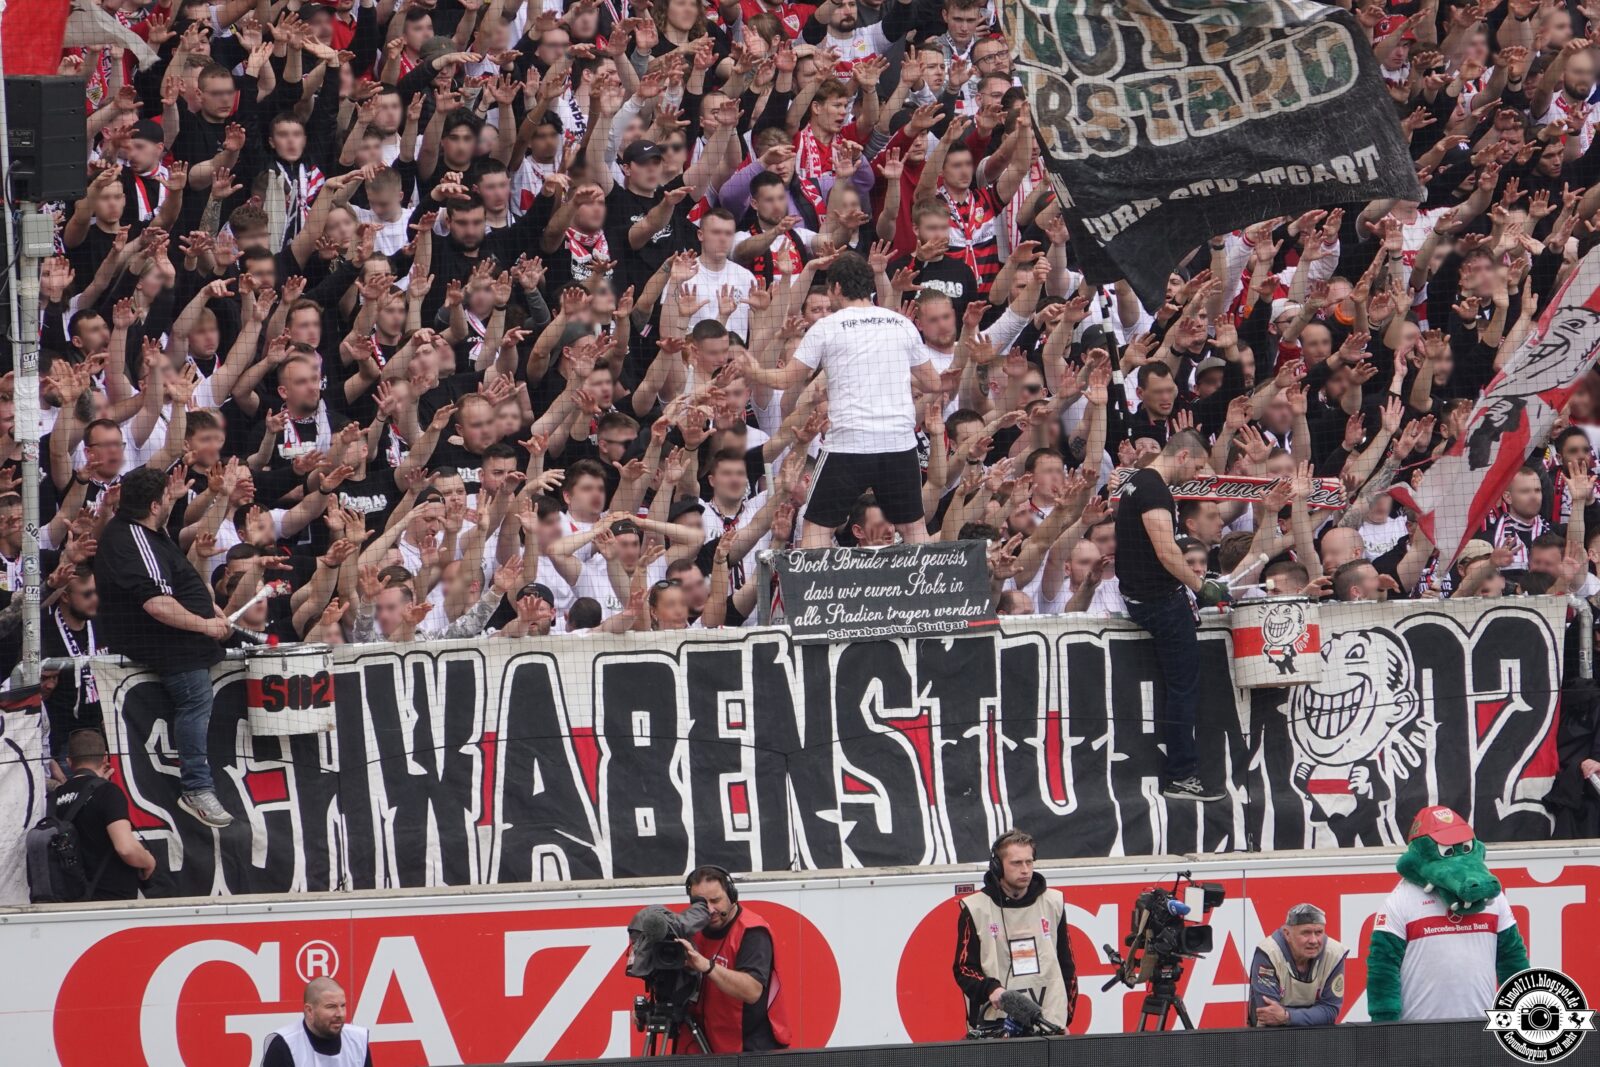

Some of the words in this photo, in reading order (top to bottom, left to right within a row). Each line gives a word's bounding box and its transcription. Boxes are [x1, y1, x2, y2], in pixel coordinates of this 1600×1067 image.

[788, 549, 830, 573] Doch
[832, 548, 889, 572] Brüder
[890, 546, 922, 568] seid
[919, 550, 968, 574] gewiss,
[804, 581, 833, 601] dass
[838, 583, 862, 599] wir
[864, 585, 902, 598] euren
[904, 572, 946, 596] Stolz
[949, 577, 964, 593] in
[794, 605, 822, 626] alle
[825, 603, 884, 625] Stadien
[886, 605, 931, 625] tragen
[934, 599, 990, 617] werden!
[827, 624, 917, 640] Schwabensturm
[917, 620, 969, 633] Stuttgart
[1423, 925, 1473, 935] Mercedes-Benz
[1473, 923, 1489, 931] Bank
[138, 926, 636, 1067] GAZ
